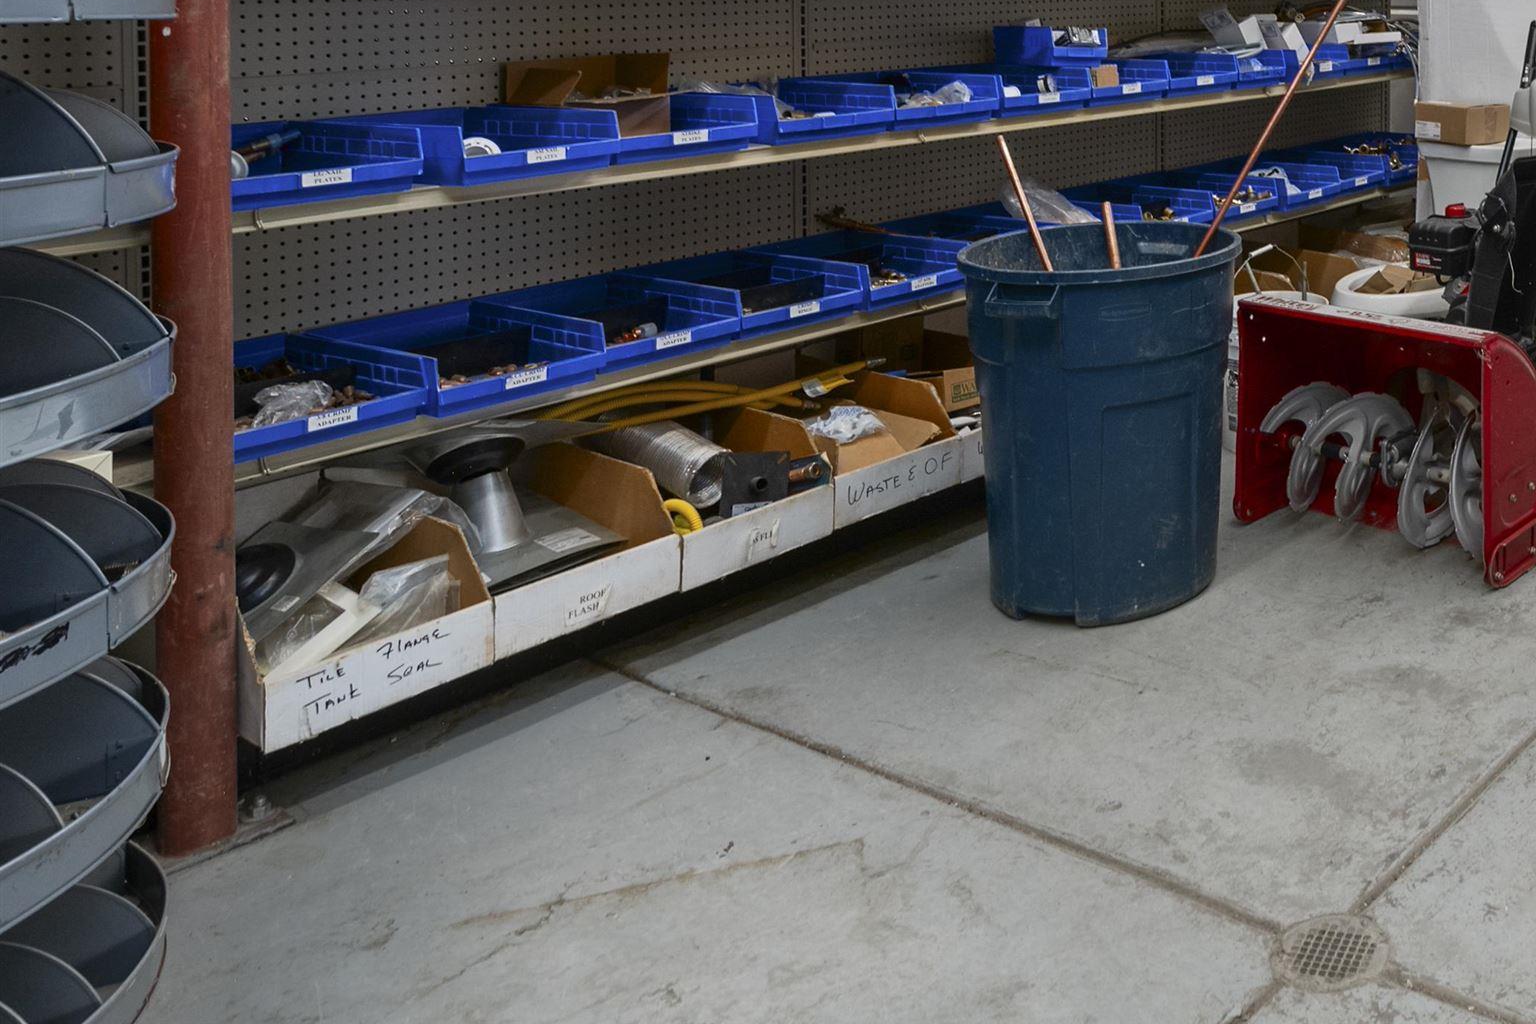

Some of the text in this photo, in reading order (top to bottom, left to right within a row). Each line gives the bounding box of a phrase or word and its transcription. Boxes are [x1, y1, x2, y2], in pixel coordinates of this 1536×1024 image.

[313, 177, 343, 185] PLATES
[513, 374, 542, 385] ADAPTER
[318, 414, 352, 427] ADAPTER
[847, 475, 902, 506] WASTE
[924, 451, 953, 475] OF
[579, 587, 607, 605] ROOF
[568, 601, 600, 620] FLASH
